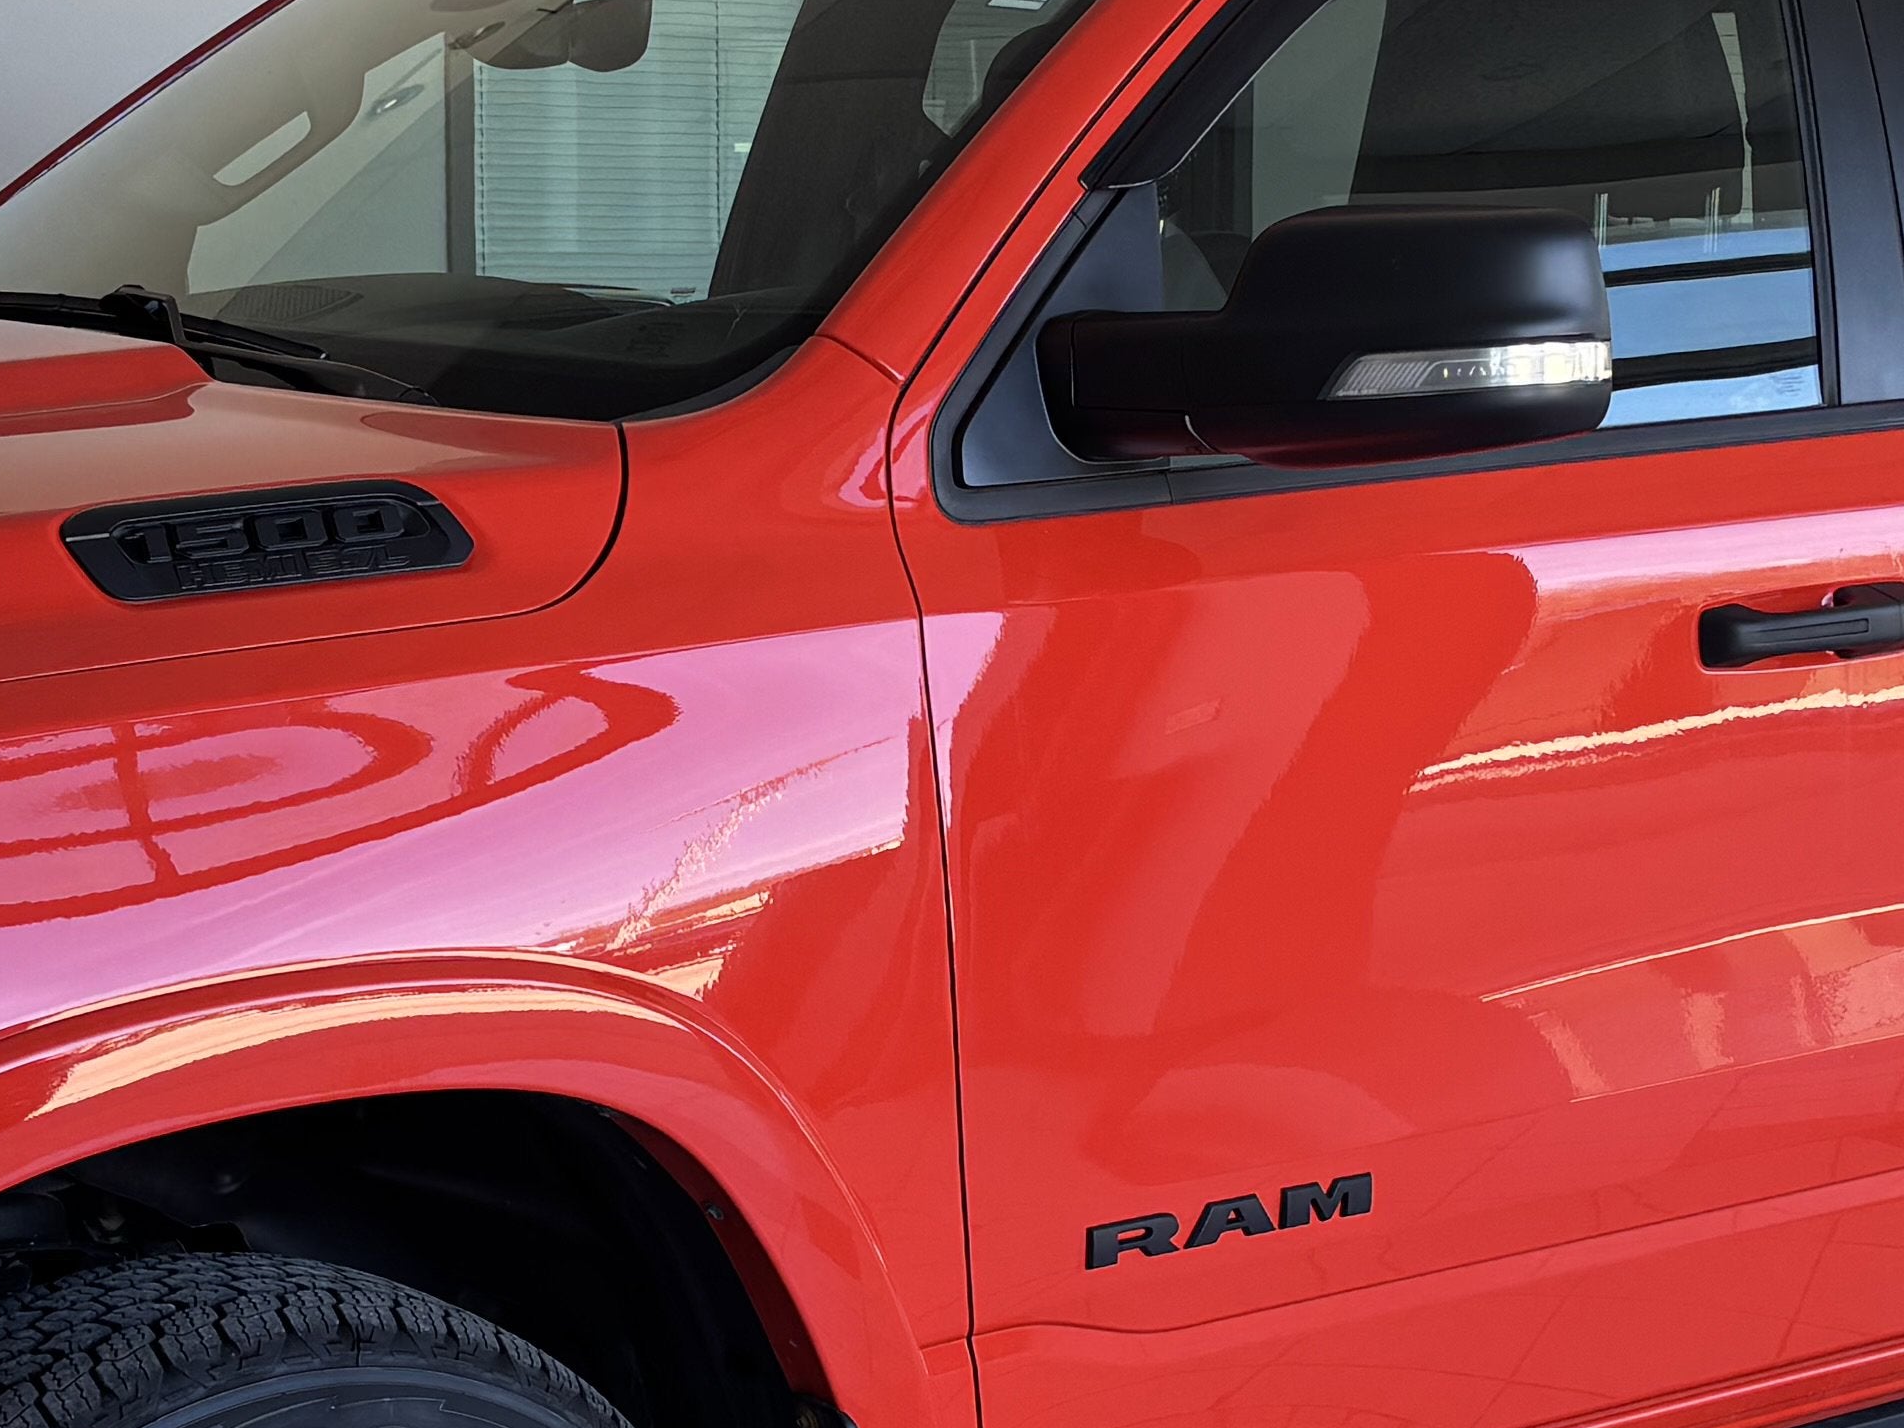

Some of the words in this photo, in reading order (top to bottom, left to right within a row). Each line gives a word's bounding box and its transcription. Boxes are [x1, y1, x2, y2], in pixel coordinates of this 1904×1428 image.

[122, 500, 406, 564] 1500
[176, 549, 302, 590] HEMI
[306, 545, 411, 578] 5.7L
[1084, 1171, 1374, 1270] RAM
